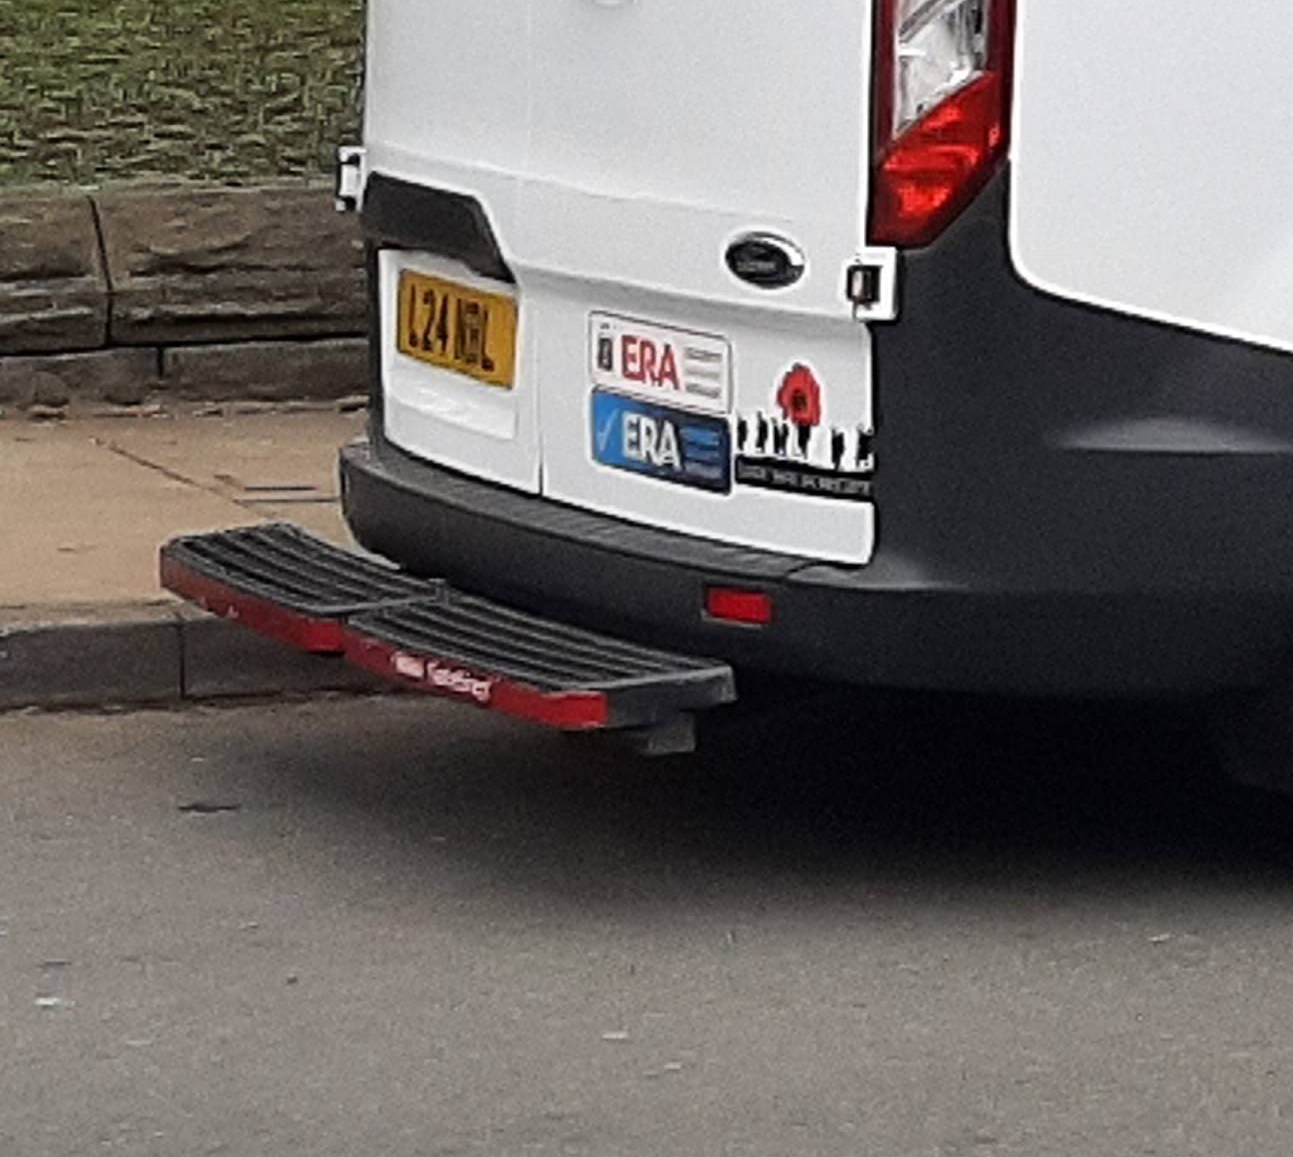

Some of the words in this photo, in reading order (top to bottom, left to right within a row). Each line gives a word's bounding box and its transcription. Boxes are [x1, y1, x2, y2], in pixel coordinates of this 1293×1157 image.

[407, 283, 449, 354] L24
[620, 334, 680, 391] ERA
[621, 411, 683, 472] ERA
